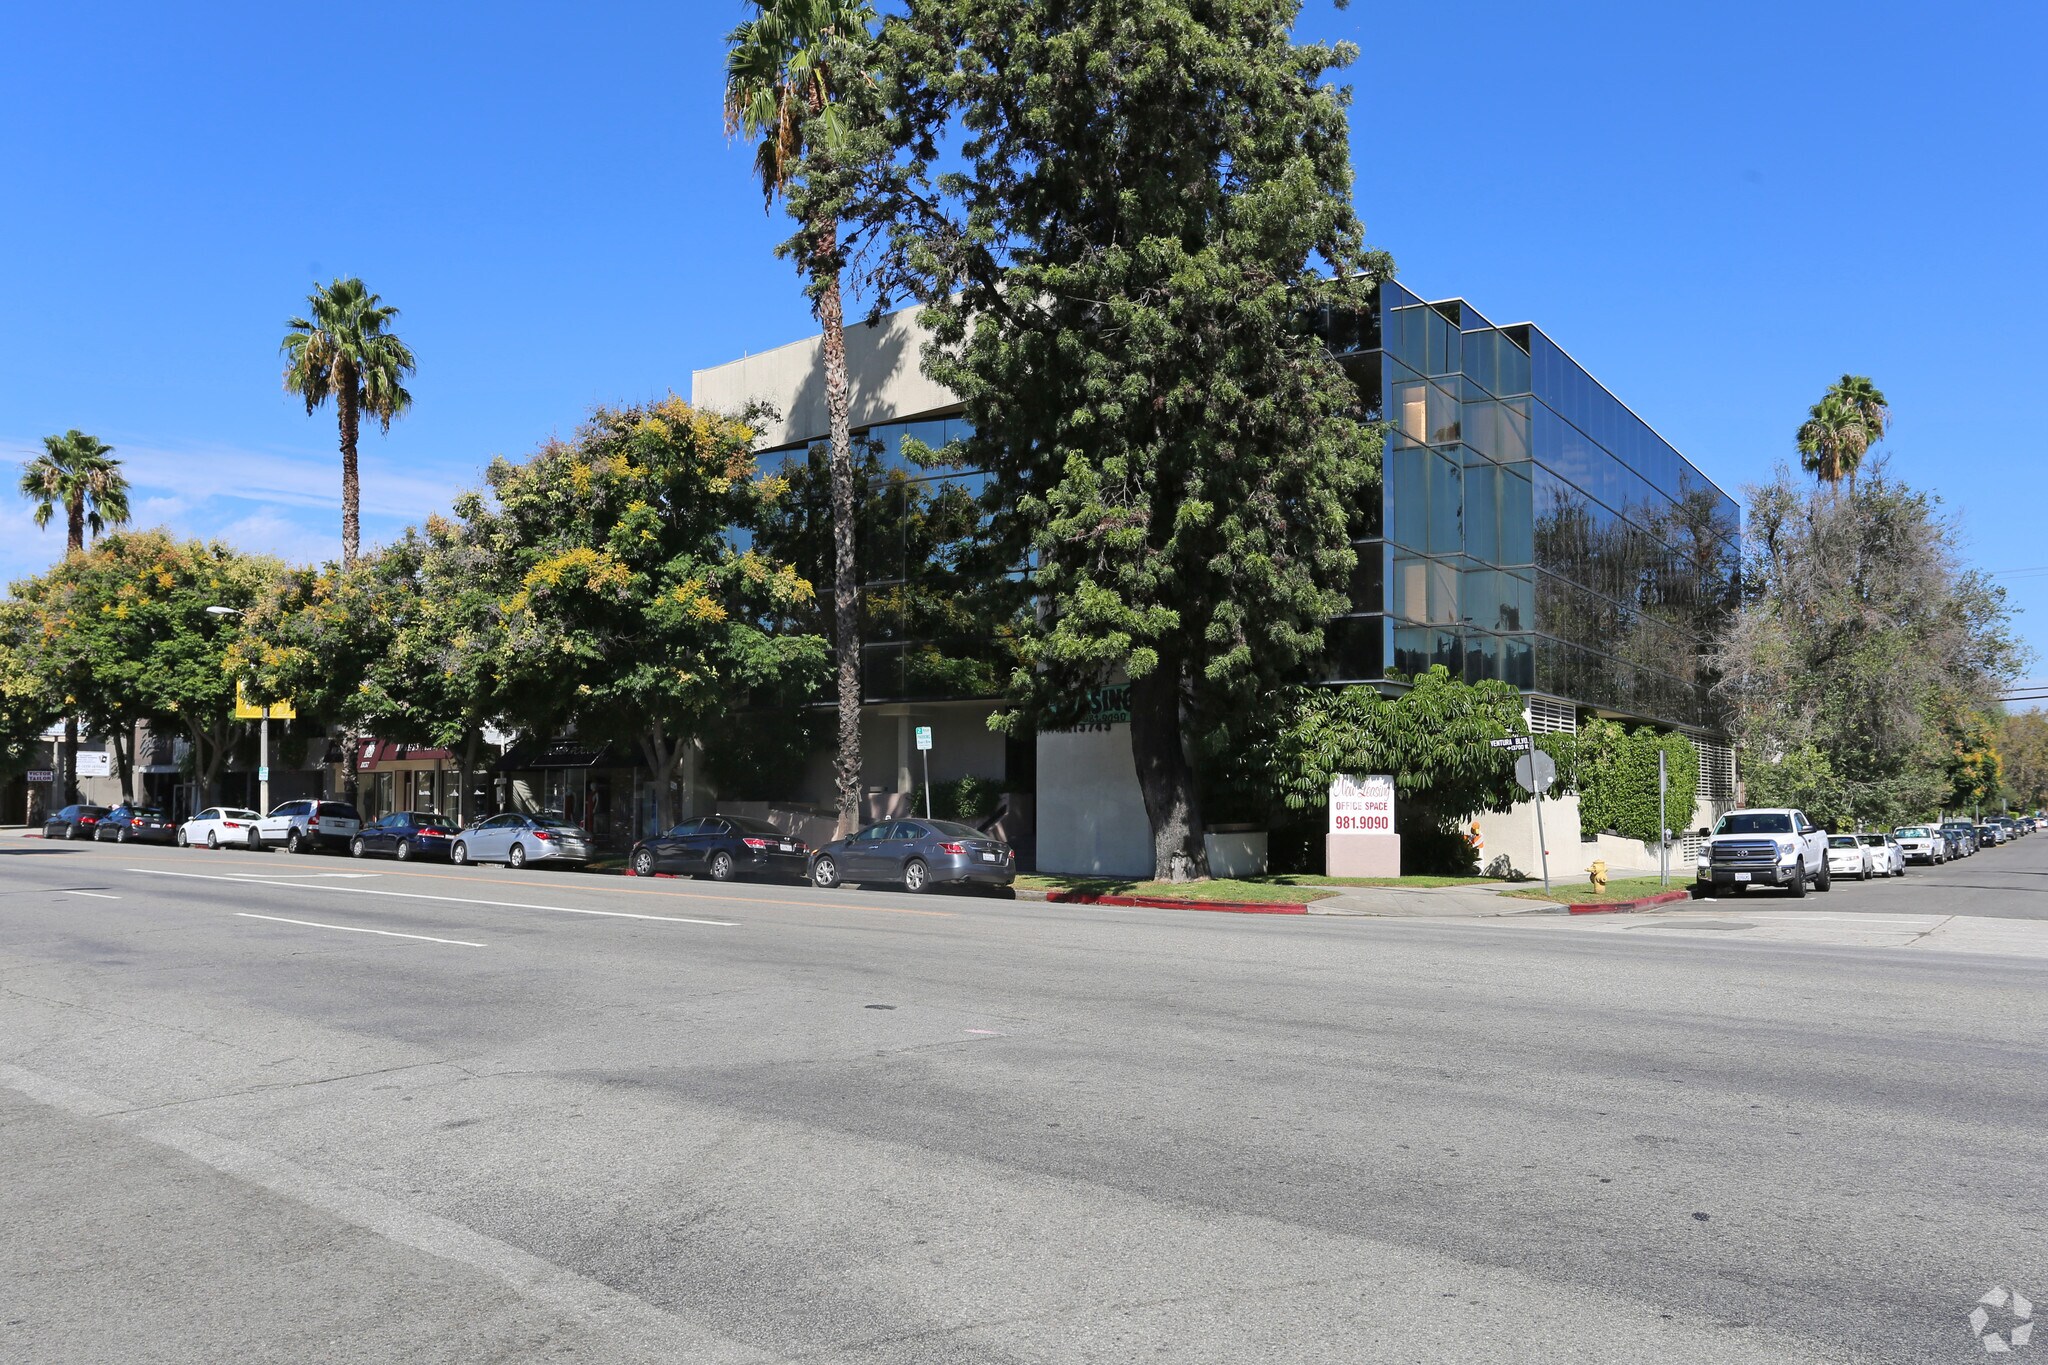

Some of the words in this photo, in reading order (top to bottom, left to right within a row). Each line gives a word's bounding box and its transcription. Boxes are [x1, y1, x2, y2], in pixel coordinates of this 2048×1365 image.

[1490, 739, 1513, 747] VENTURA
[1357, 780, 1390, 801] Leasing
[1336, 802, 1362, 811] OFFICE
[1364, 802, 1388, 811] SPACE
[1336, 816, 1388, 829] 981.9090
